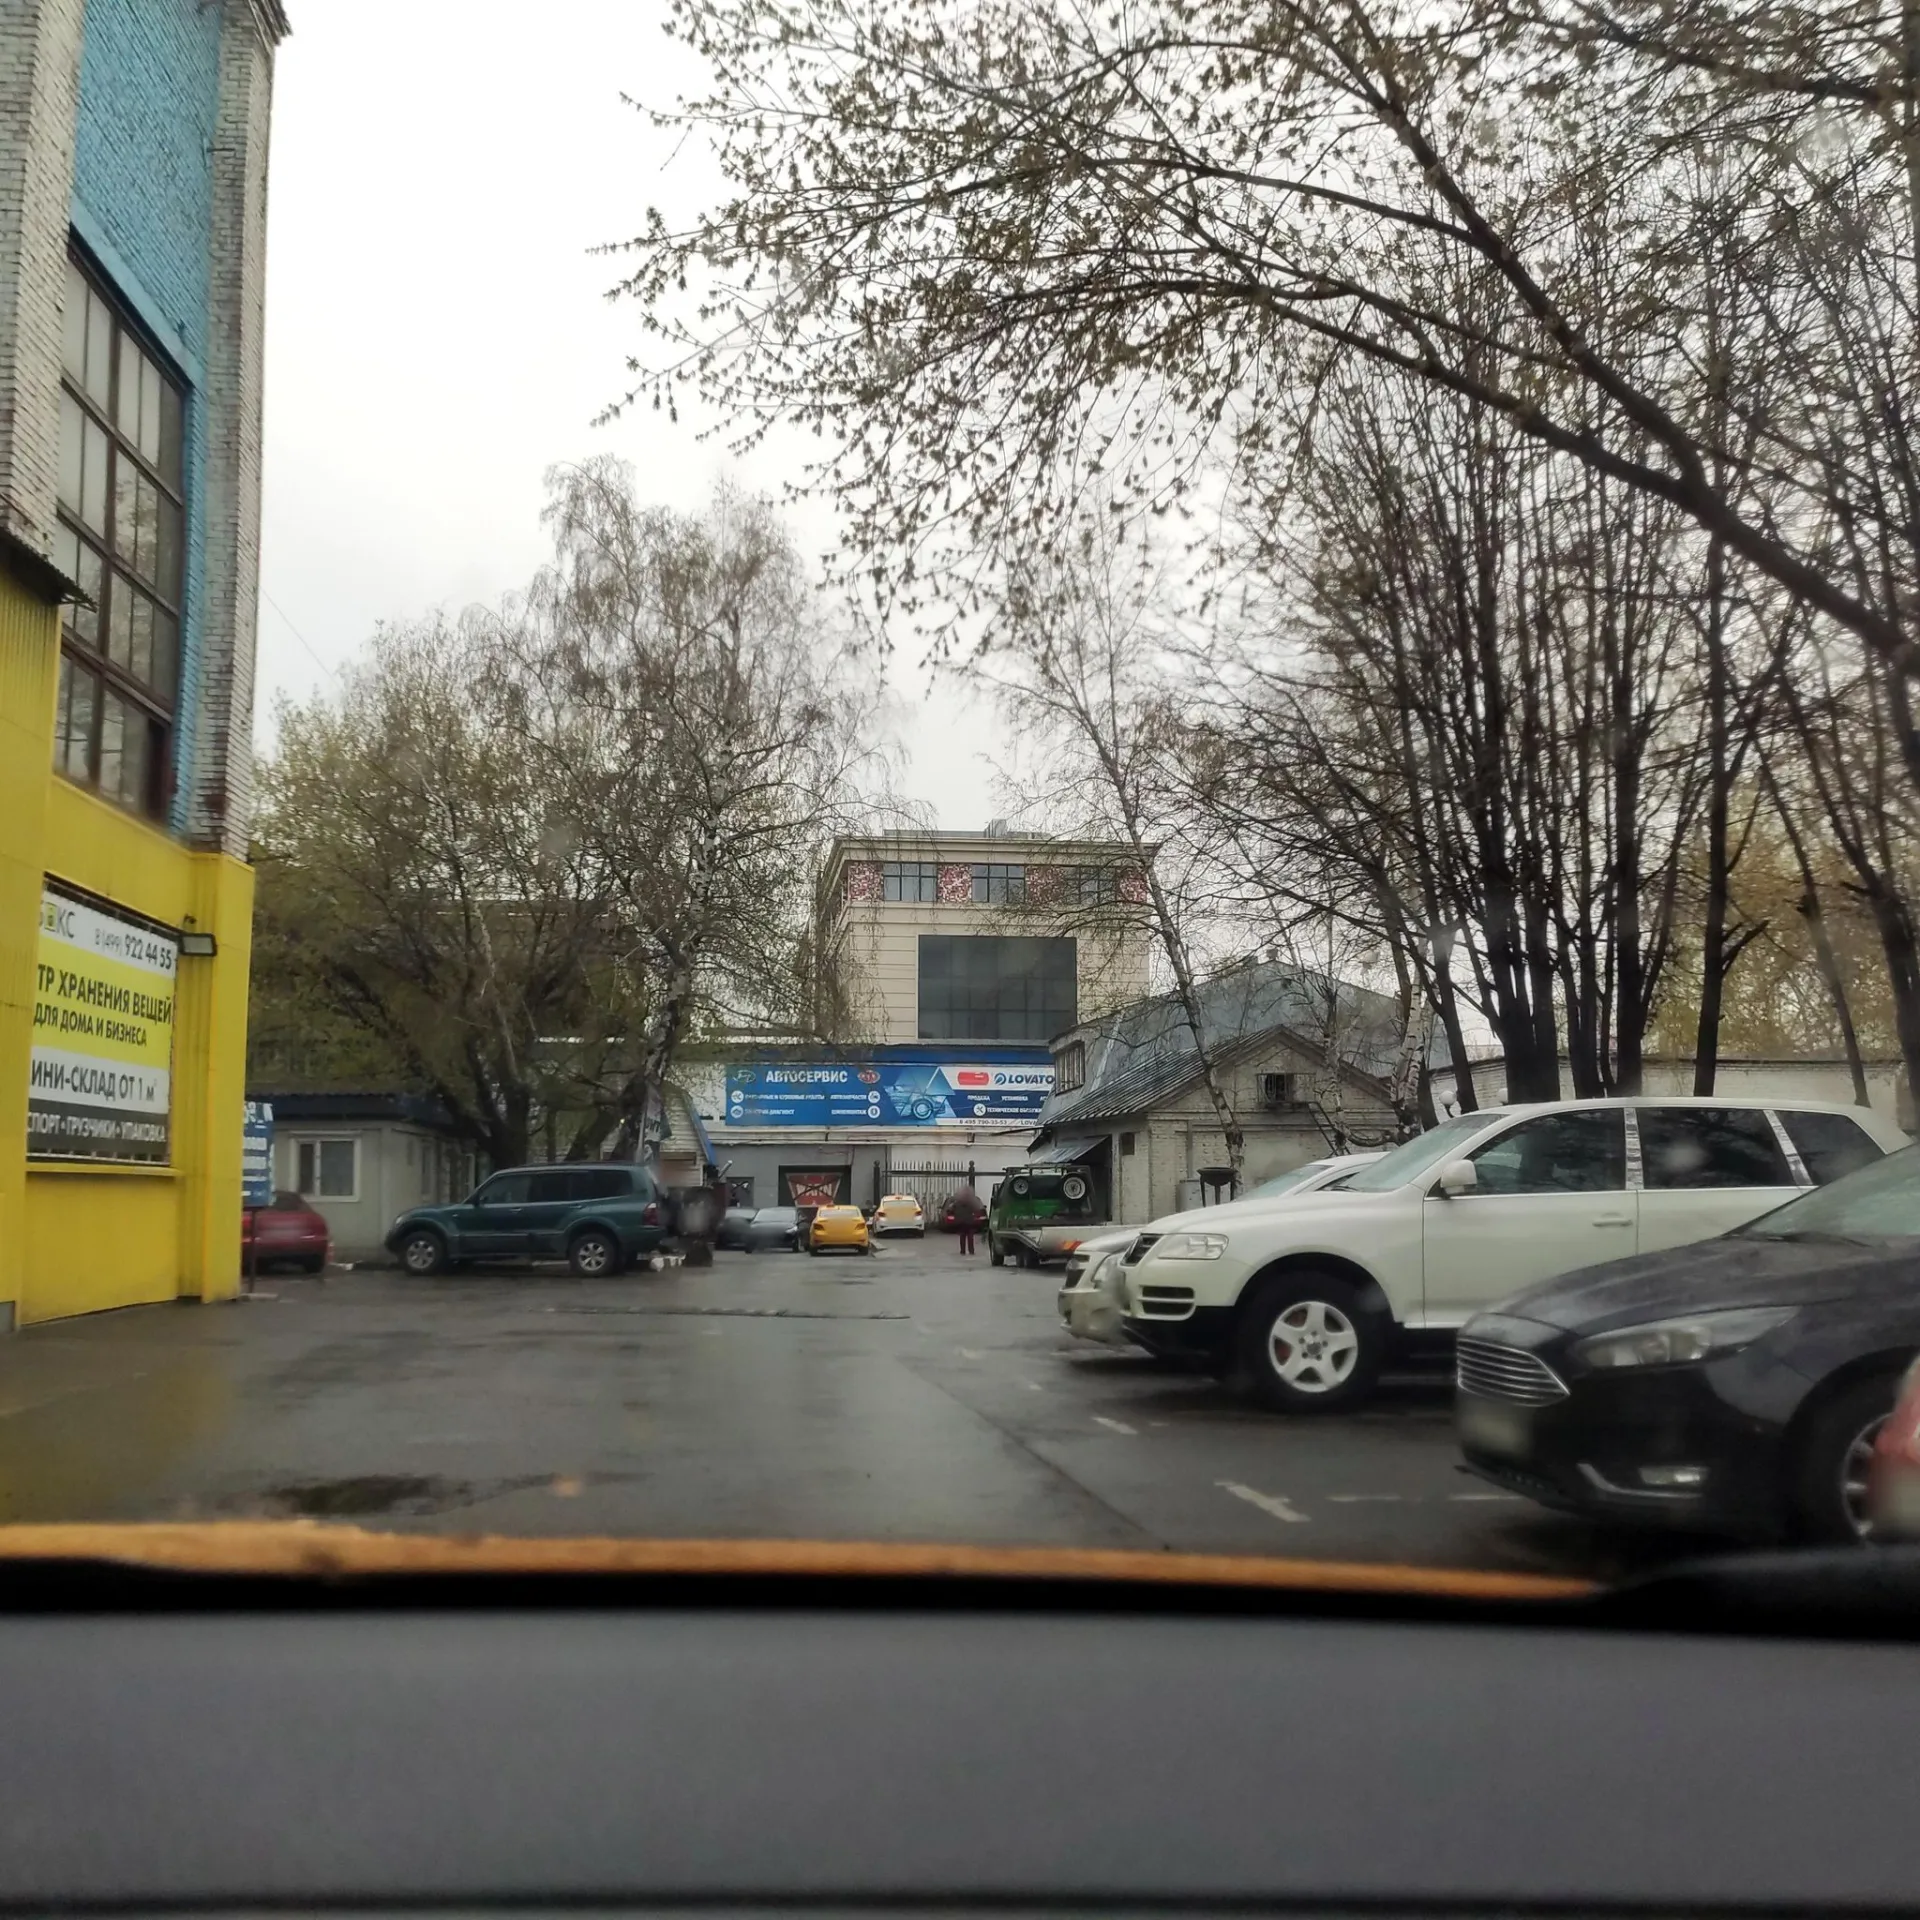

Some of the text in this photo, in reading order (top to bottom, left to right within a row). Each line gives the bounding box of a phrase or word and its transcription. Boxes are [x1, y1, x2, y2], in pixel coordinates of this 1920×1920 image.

[125, 933, 143, 960] 922
[146, 942, 158, 965] 44
[160, 947, 172, 970] 55
[57, 969, 130, 1014] ХРАНЕНИЯ
[132, 991, 172, 1025] ВЕЩЕЙ
[33, 1002, 147, 1046] ДЛЯ ДОМА И БИЗНЕСА
[119, 1074, 135, 1100] ОТ
[138, 1077, 143, 1101] 1
[765, 1070, 848, 1083] АВТОСЕРВИС
[1008, 1074, 1055, 1085] LOVATO
